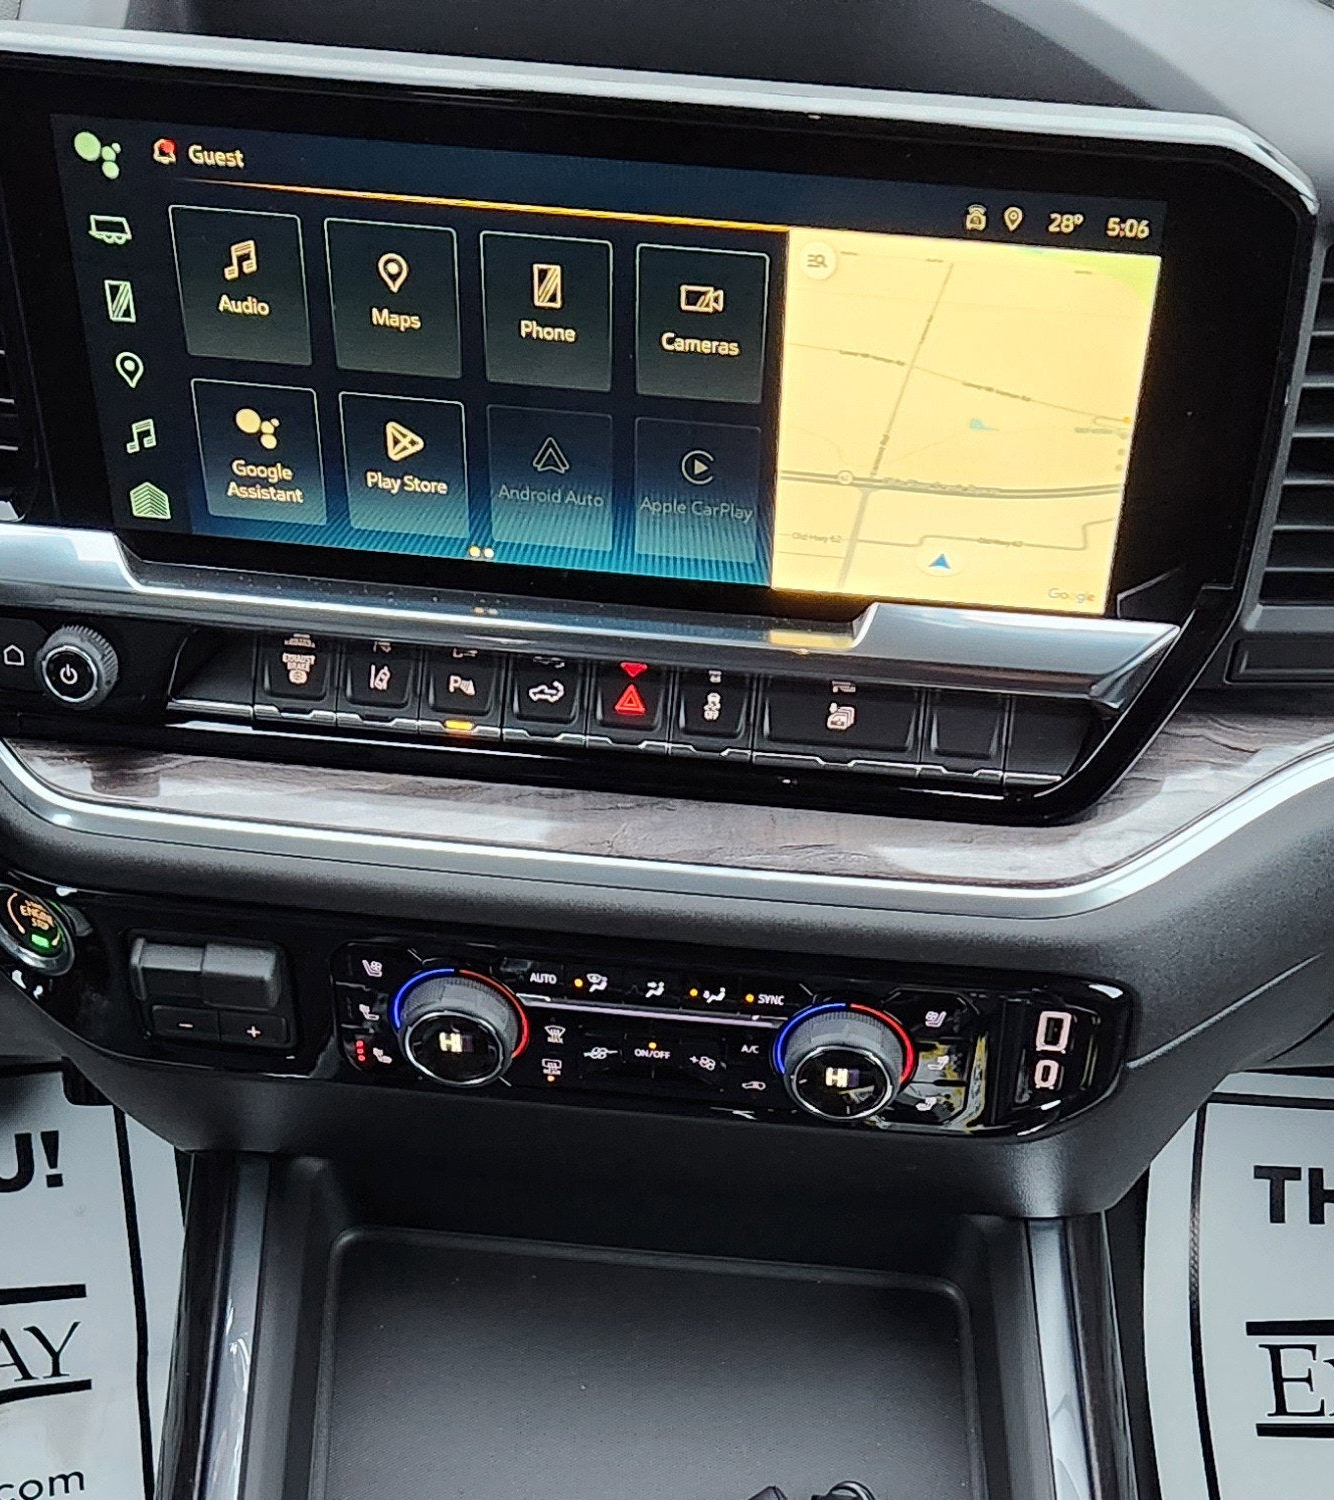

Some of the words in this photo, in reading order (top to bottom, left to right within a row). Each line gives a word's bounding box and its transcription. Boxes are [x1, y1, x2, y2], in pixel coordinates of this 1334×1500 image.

[187, 143, 245, 169] Guest
[1105, 217, 1151, 240] 5:06
[217, 293, 270, 317] Audio
[370, 307, 422, 332] Maps
[519, 319, 577, 344] Phone
[660, 331, 741, 357] Cameras
[231, 458, 294, 484] Google
[365, 470, 403, 495] Play
[403, 473, 449, 496] Store
[226, 481, 305, 505] Assistant
[497, 483, 563, 505] Android
[565, 489, 605, 507] Auto
[639, 496, 688, 516] Apple
[690, 499, 754, 523] CarPlay
[529, 972, 558, 985] AUTO
[757, 993, 785, 1006] SYNC
[633, 1048, 671, 1060] ON/OFF
[740, 1044, 760, 1055] A/C
